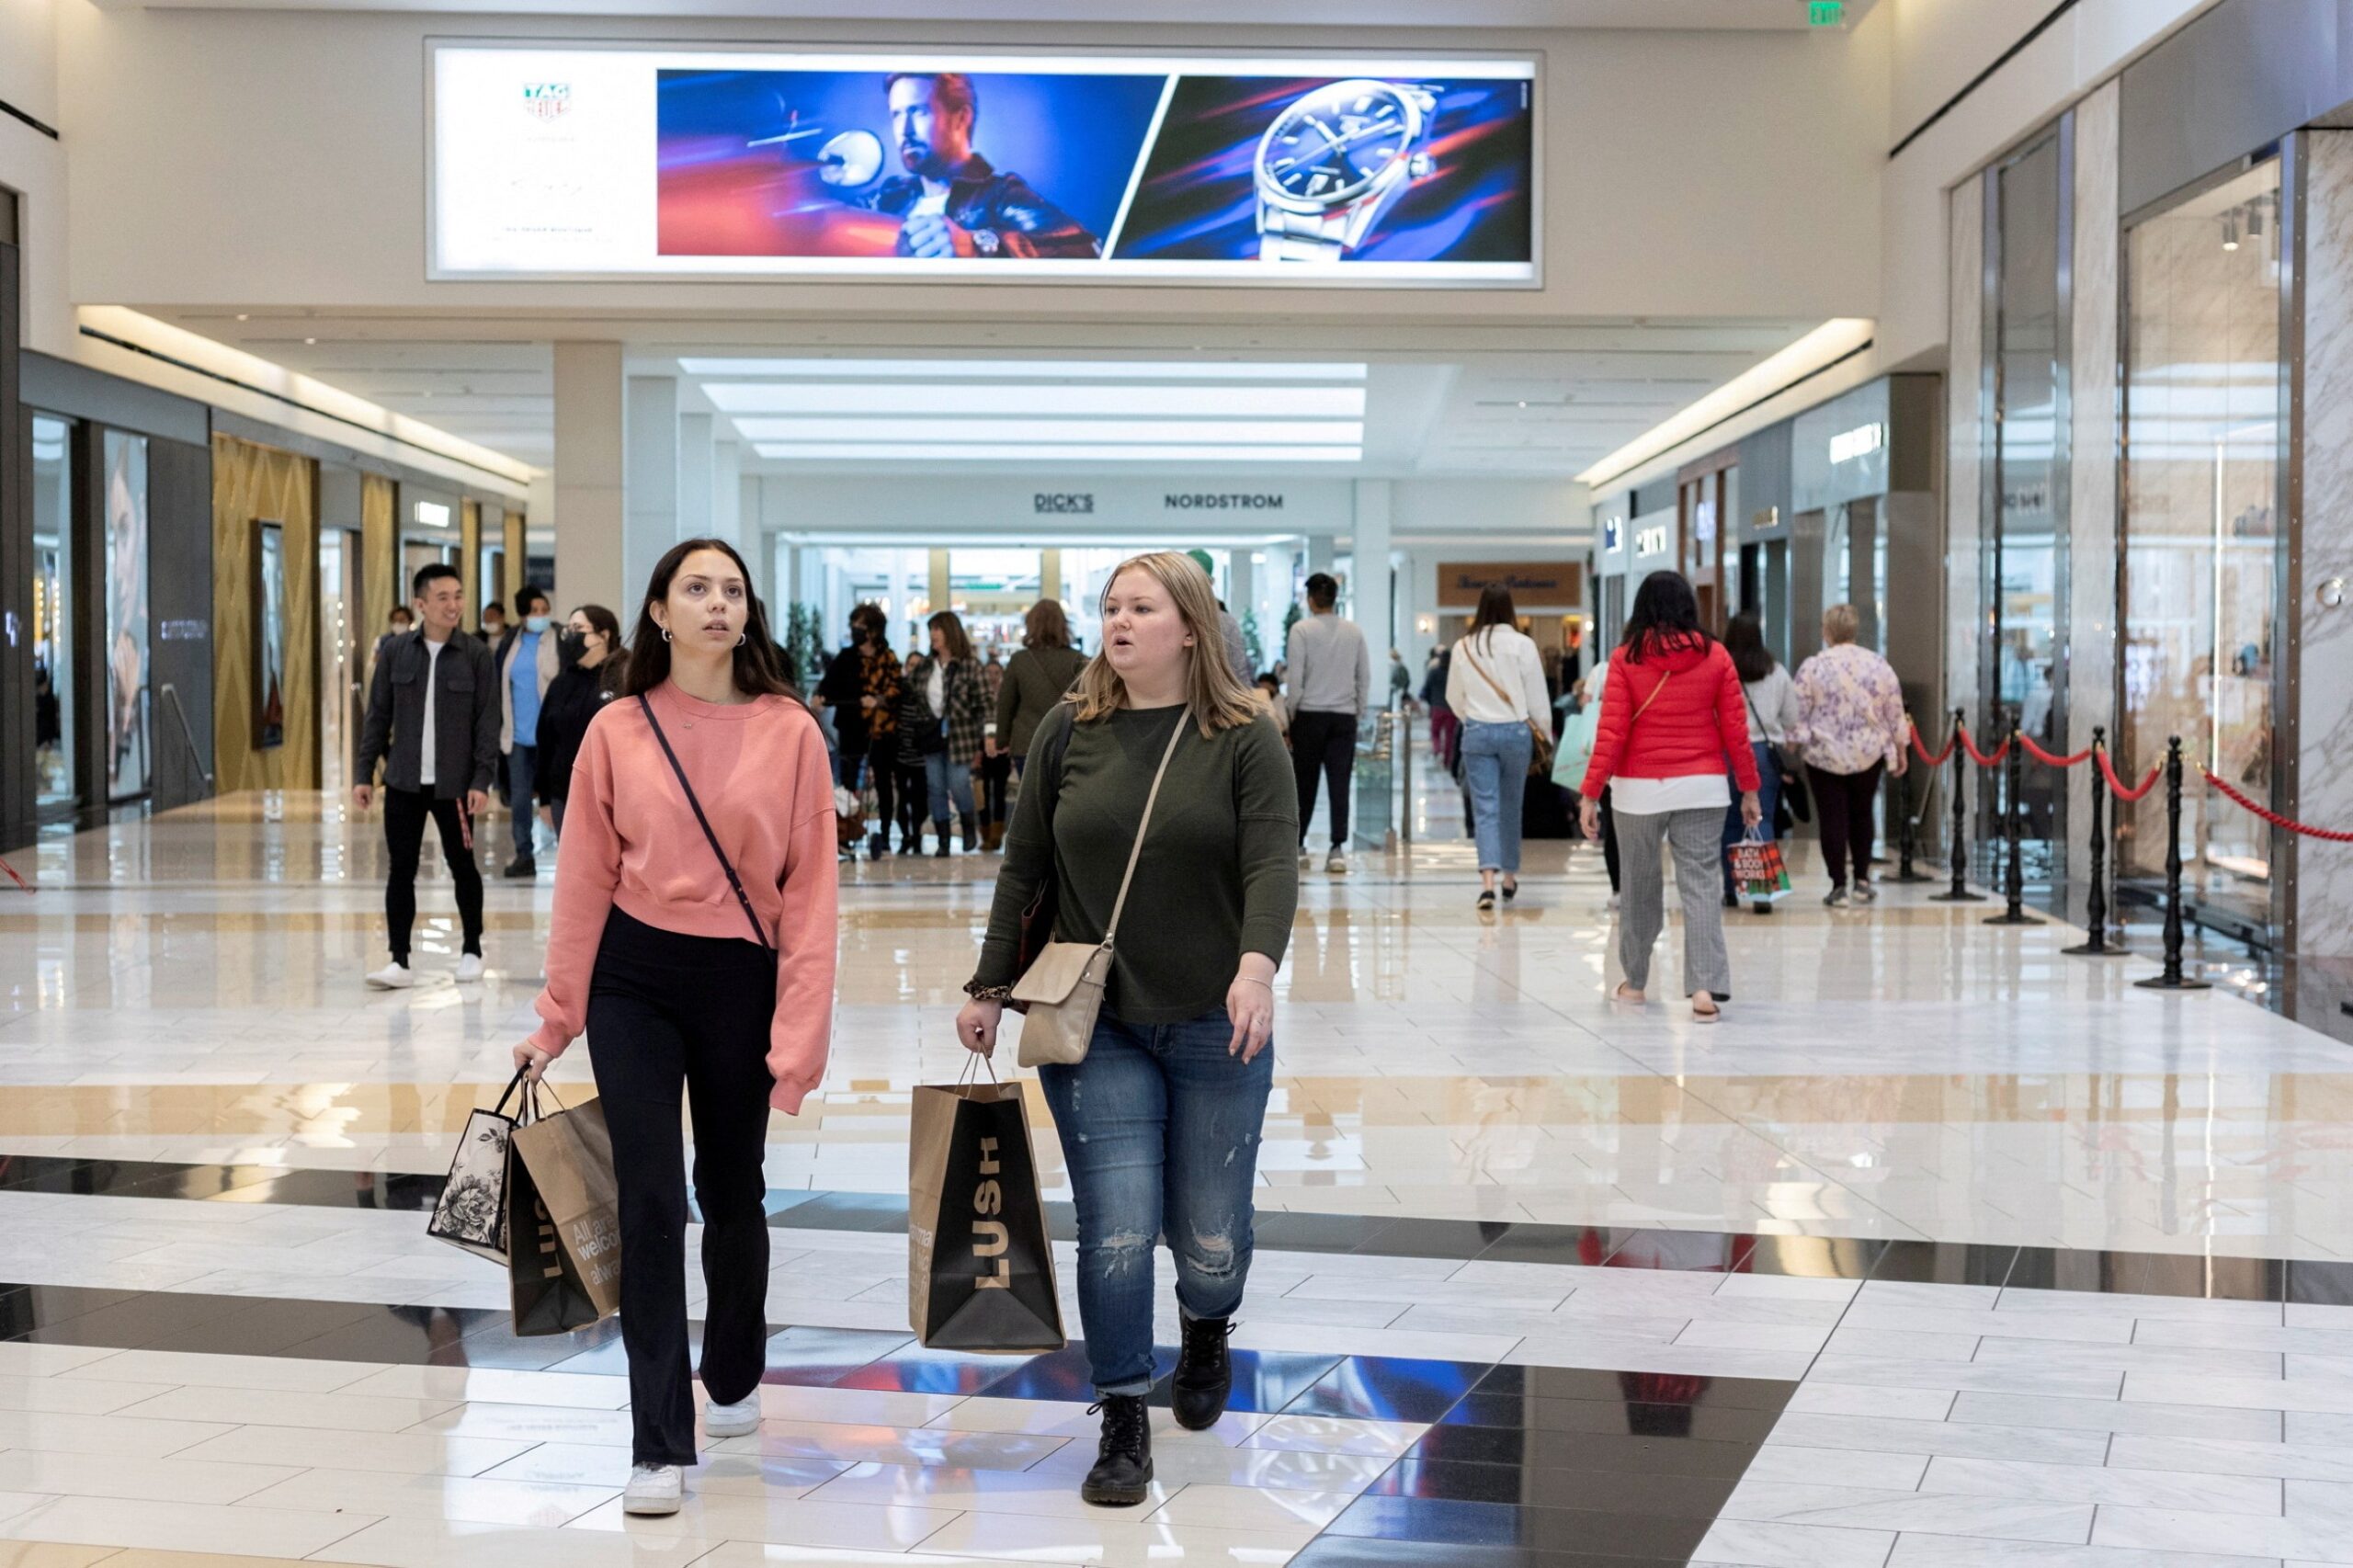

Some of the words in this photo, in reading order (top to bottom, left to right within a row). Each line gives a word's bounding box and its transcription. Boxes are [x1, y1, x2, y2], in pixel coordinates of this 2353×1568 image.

[1165, 494, 1284, 508] NORDSTROM
[972, 1137, 1010, 1289] LUSH
[574, 1220, 593, 1245] All
